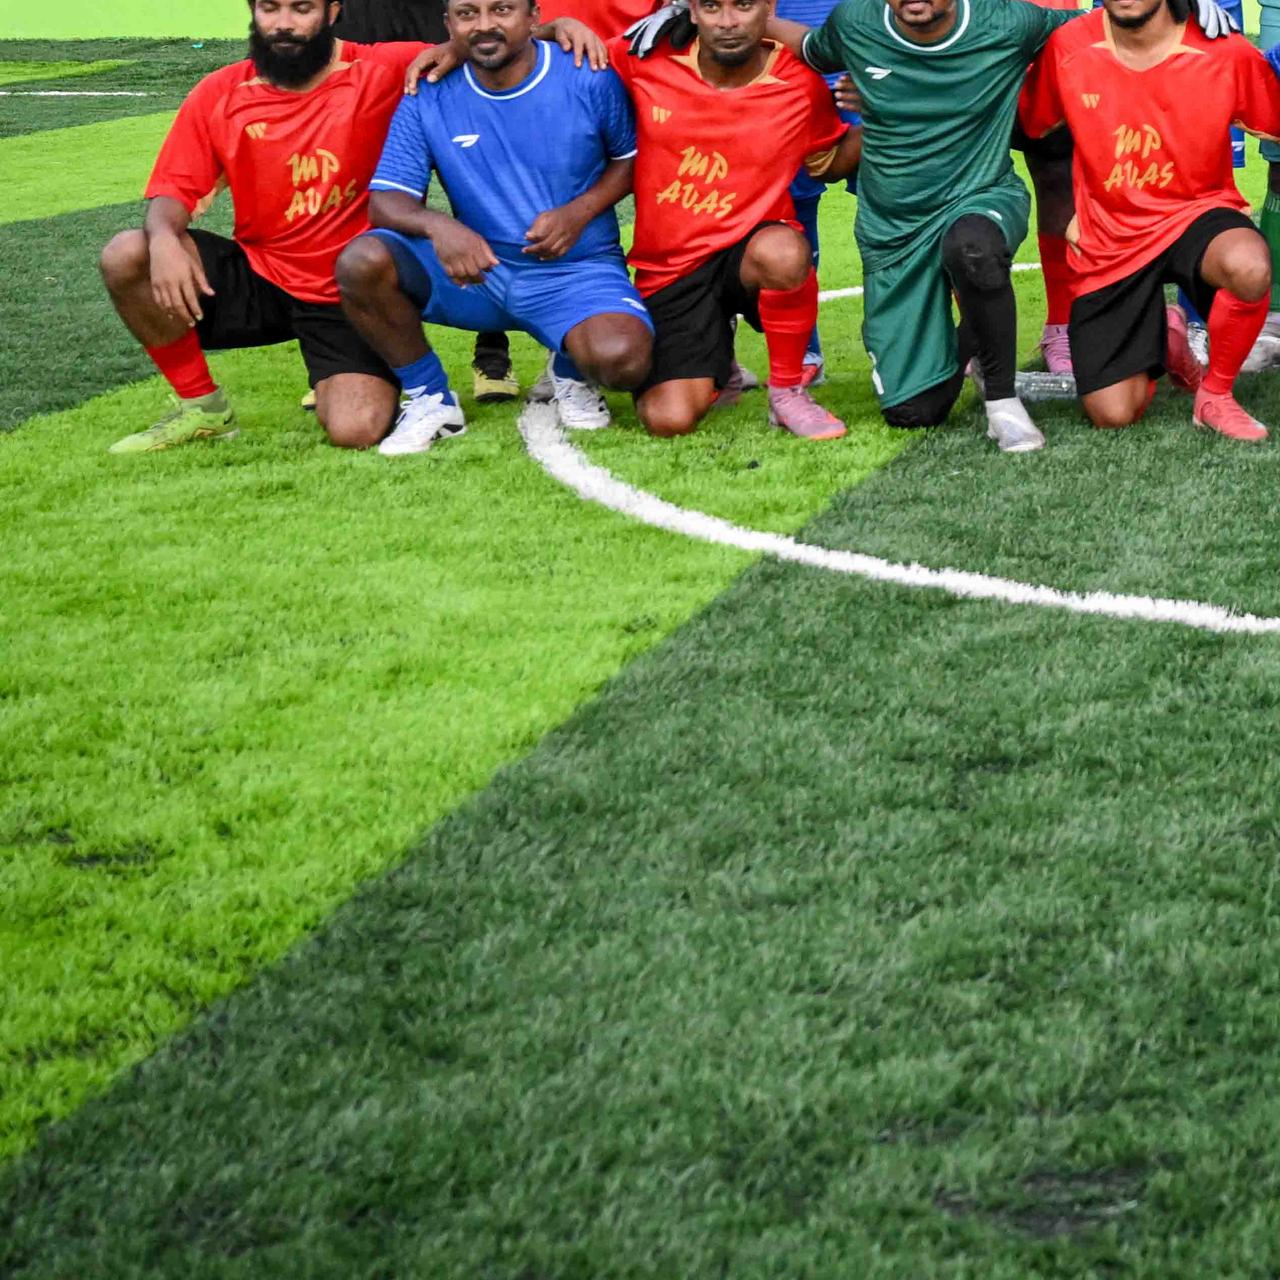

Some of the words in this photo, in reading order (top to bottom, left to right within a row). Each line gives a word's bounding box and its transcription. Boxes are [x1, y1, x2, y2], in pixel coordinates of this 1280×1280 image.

[1112, 123, 1163, 160] MP
[287, 147, 340, 188] MP
[677, 145, 729, 185] MP
